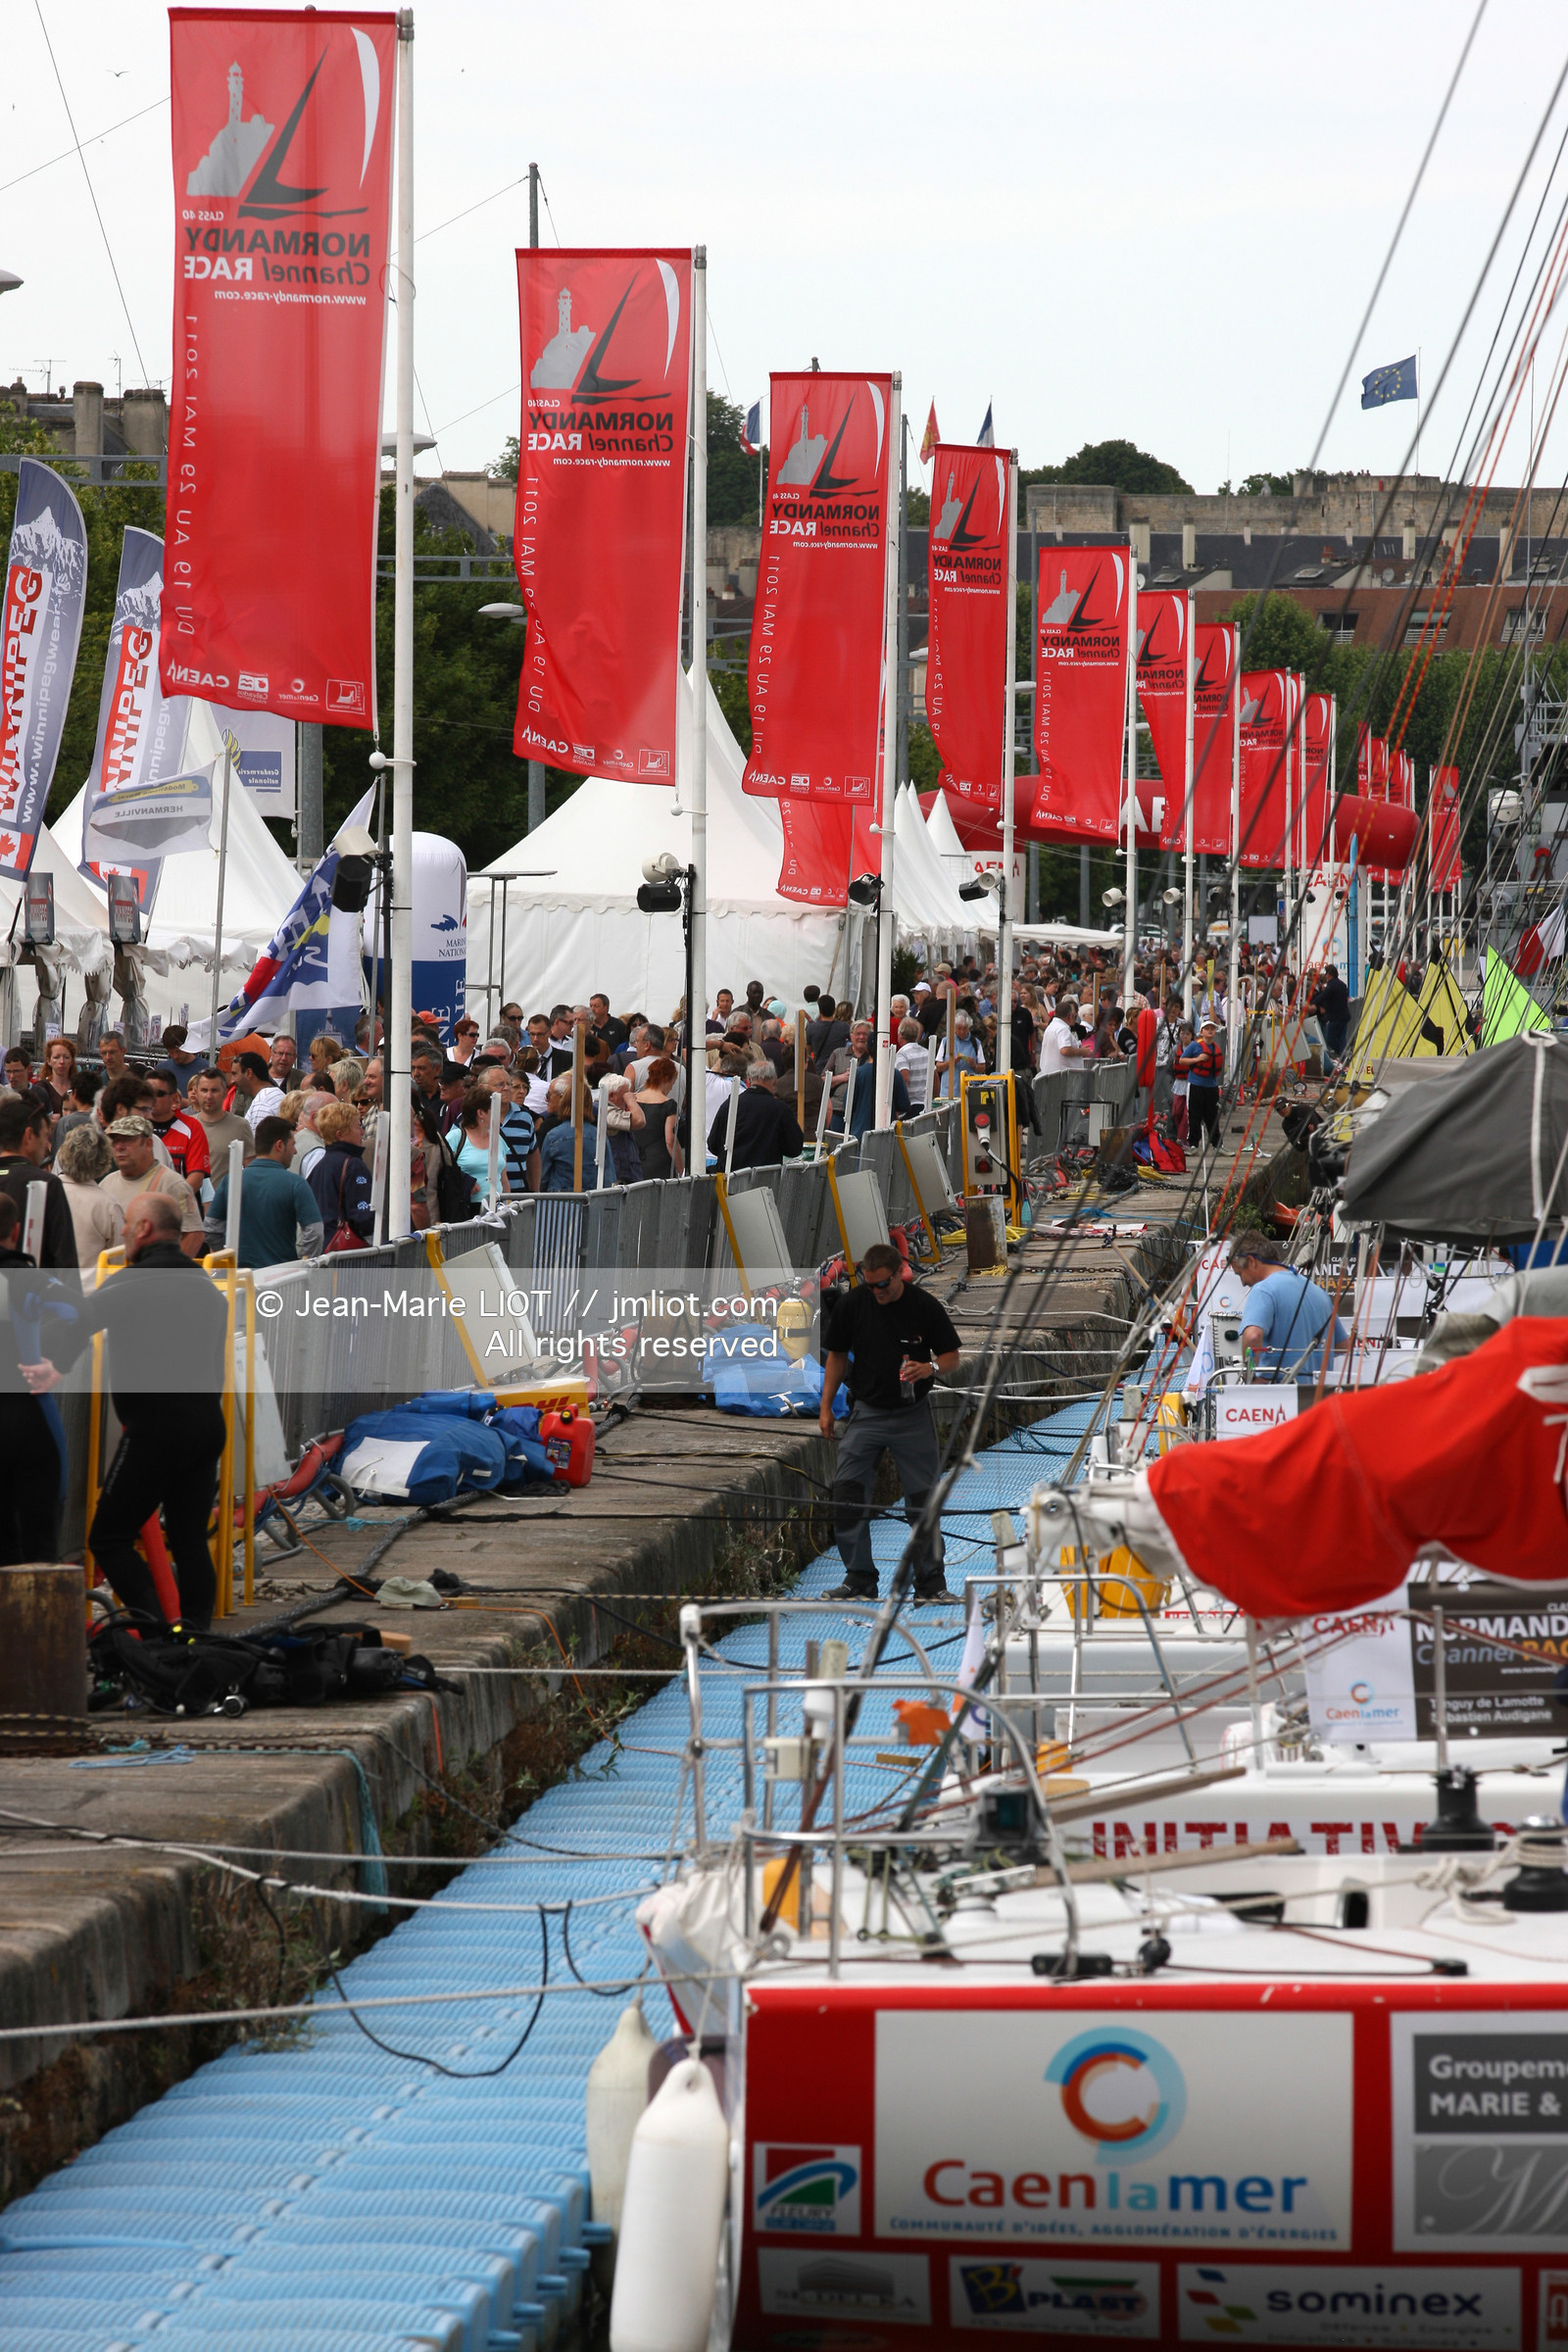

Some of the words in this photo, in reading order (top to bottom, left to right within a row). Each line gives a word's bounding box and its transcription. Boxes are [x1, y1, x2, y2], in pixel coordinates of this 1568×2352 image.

[105, 630, 153, 791] NNIPEG
[1226, 1408, 1274, 1422] CAEN
[1416, 1642, 1515, 1665] Cannel
[1430, 1698, 1474, 1710] Tnguy
[1477, 1698, 1492, 1708] de
[1494, 1696, 1544, 1708] Lamotte
[1431, 1711, 1492, 1723] Sbastien
[1494, 1710, 1552, 1723] Audigane
[1429, 2054, 1568, 2085] Groupem
[1430, 2092, 1530, 2116] MARIE
[1538, 2092, 1561, 2116] &
[1266, 2283, 1481, 2317] sominex
